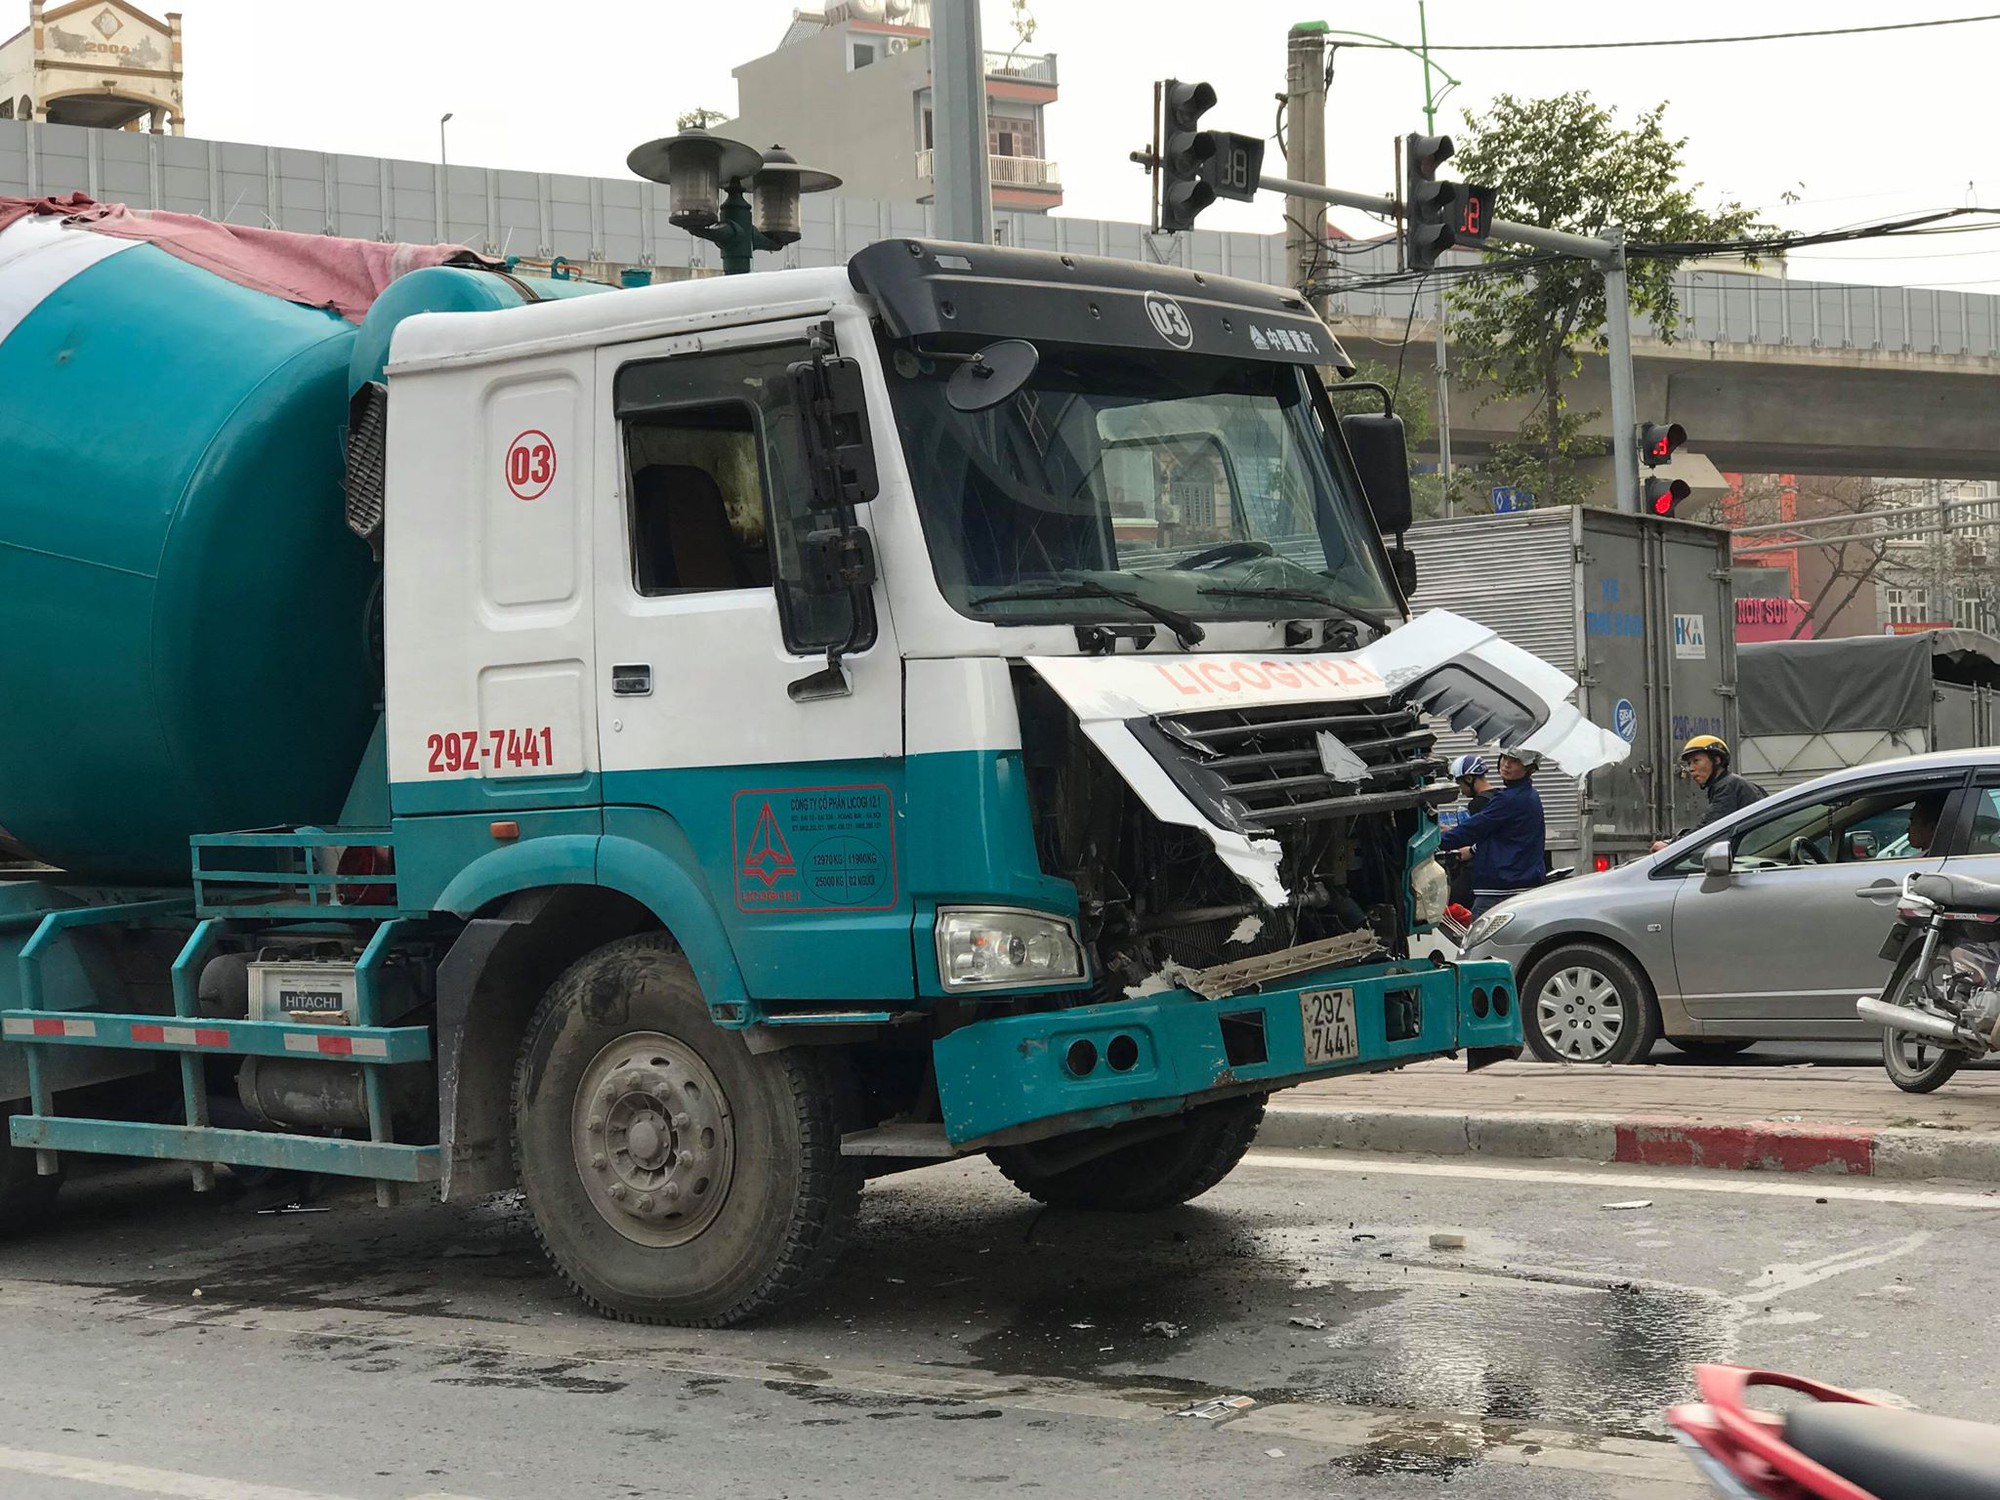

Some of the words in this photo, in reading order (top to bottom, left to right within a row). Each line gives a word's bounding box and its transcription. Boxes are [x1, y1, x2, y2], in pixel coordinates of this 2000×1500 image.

[1148, 301, 1190, 338] 03
[1265, 327, 1320, 355] 中国重汽
[511, 444, 551, 486] 03
[1675, 616, 1704, 646] HKA
[1154, 660, 1321, 695] LICOGI
[426, 726, 553, 773] 29Z-7441
[846, 795, 868, 809] LICOGI
[285, 995, 337, 1009] HITACHI
[1311, 991, 1345, 1026] 29Z
[1311, 1024, 1351, 1061] 7441
